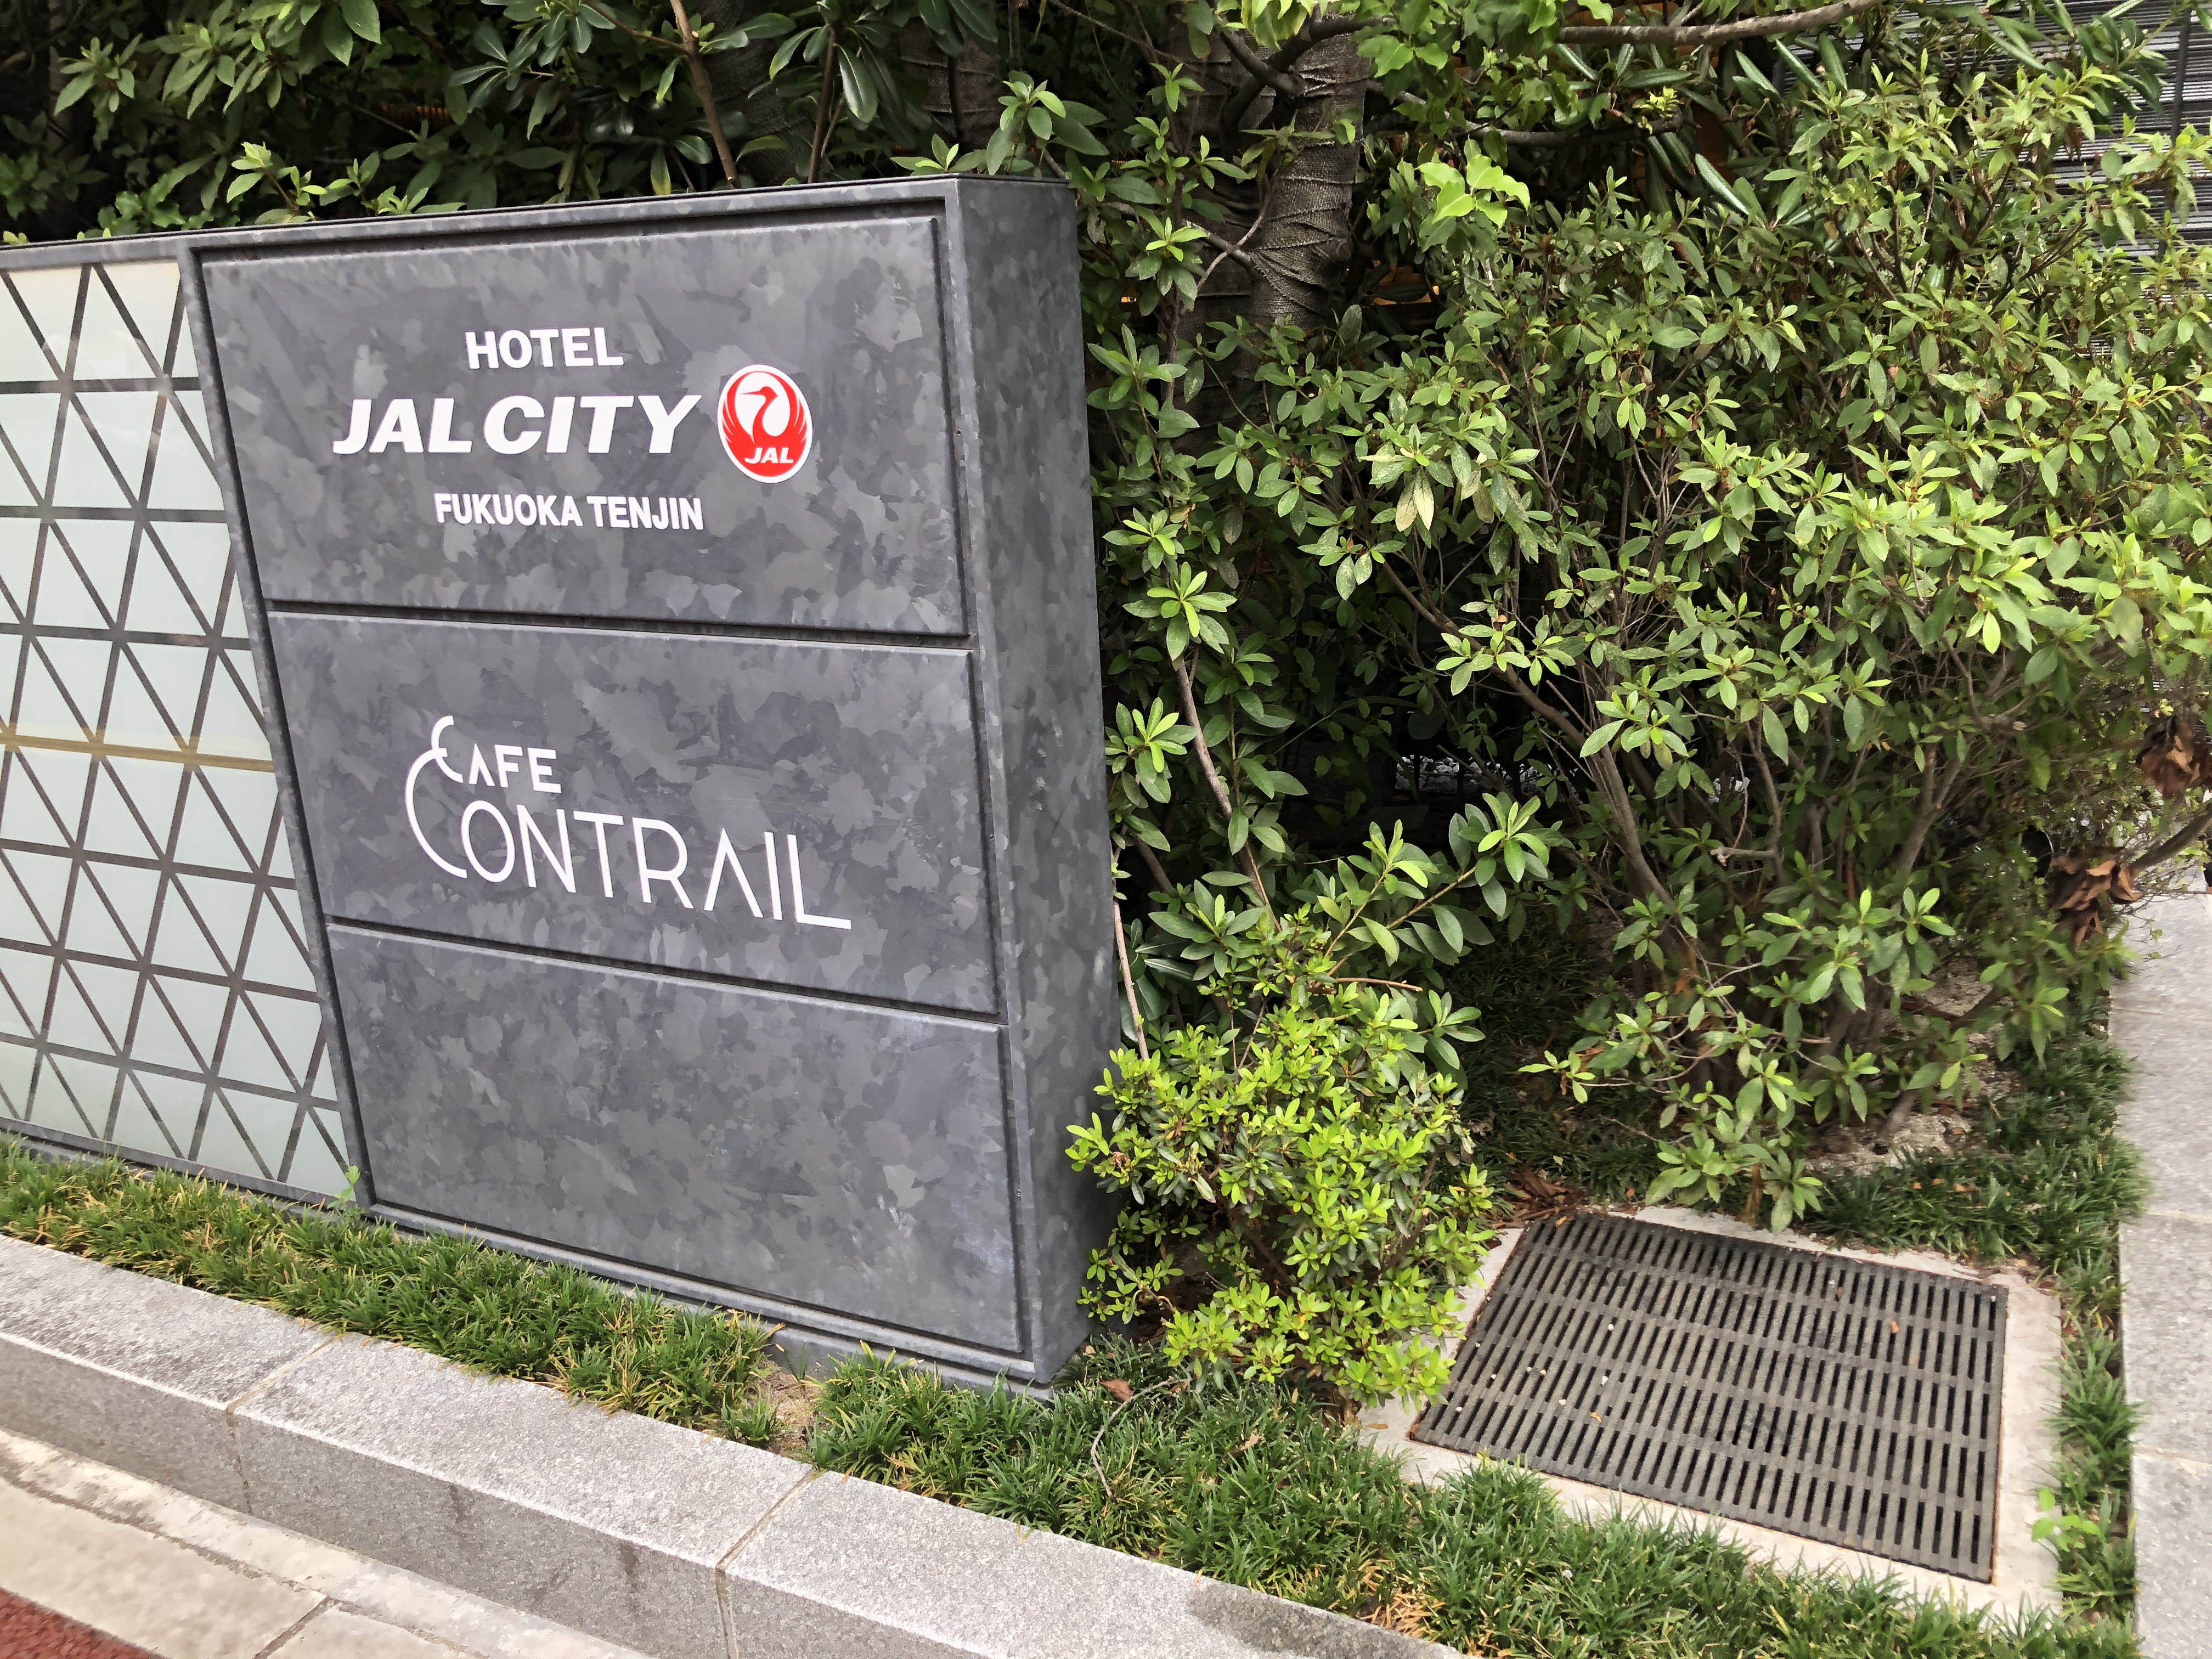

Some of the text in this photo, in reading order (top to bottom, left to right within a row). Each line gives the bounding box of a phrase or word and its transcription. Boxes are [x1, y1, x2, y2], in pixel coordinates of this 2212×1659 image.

[465, 326, 624, 370] HOTEL
[332, 394, 703, 455] JAL CITY
[744, 446, 795, 465] JAL
[433, 492, 704, 531] FUKUOKA TENJIN
[431, 715, 562, 794] CAFE
[405, 747, 853, 930] CONTRAIL
